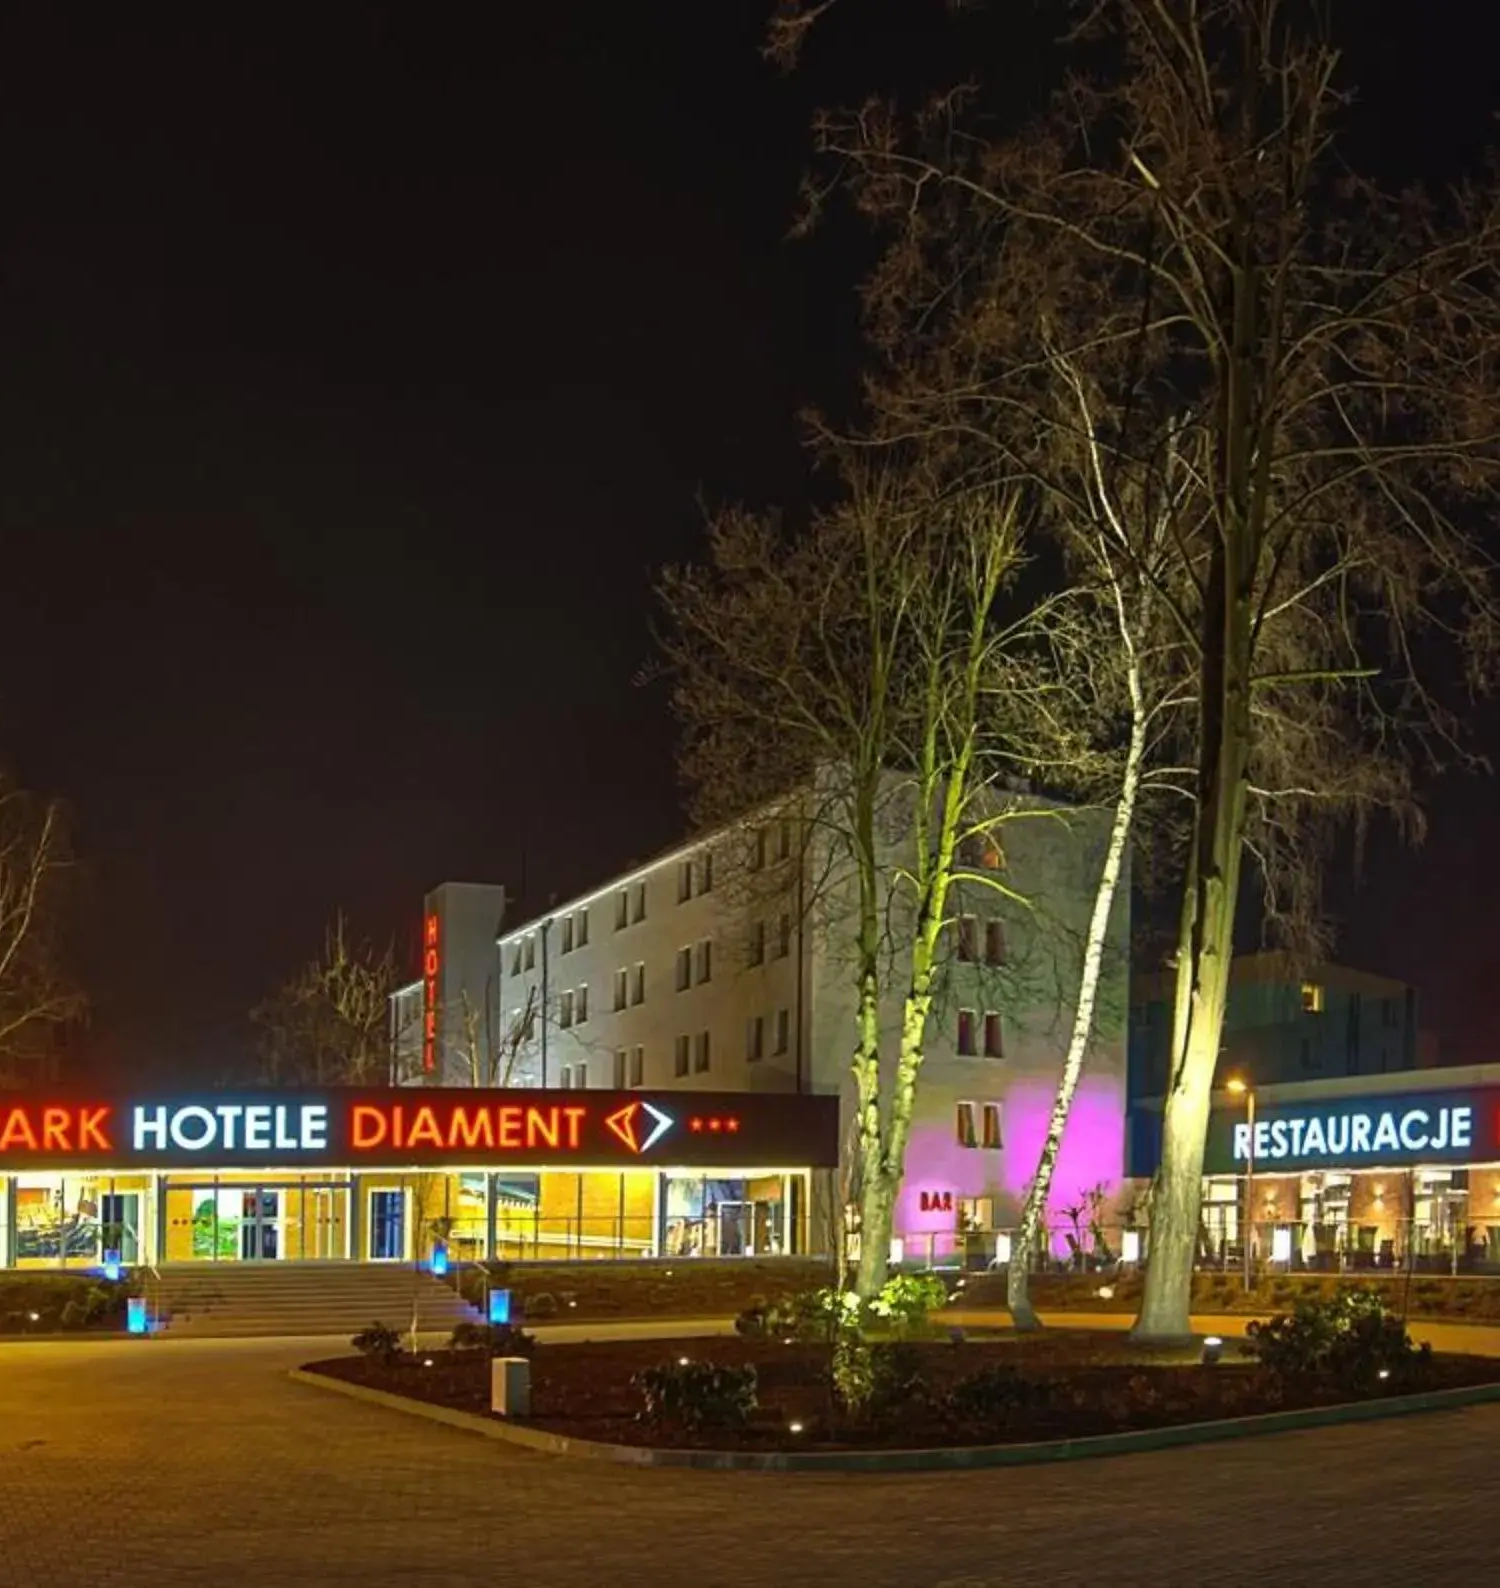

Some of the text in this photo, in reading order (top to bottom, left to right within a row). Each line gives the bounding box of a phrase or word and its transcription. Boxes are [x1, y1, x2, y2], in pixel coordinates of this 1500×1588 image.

[424, 915, 439, 1071] HOTEL
[133, 1105, 327, 1150] HOTELE
[351, 1106, 585, 1148] DIAMENT
[1233, 1107, 1471, 1160] RESTAURACJE
[920, 1191, 953, 1212] BAR
